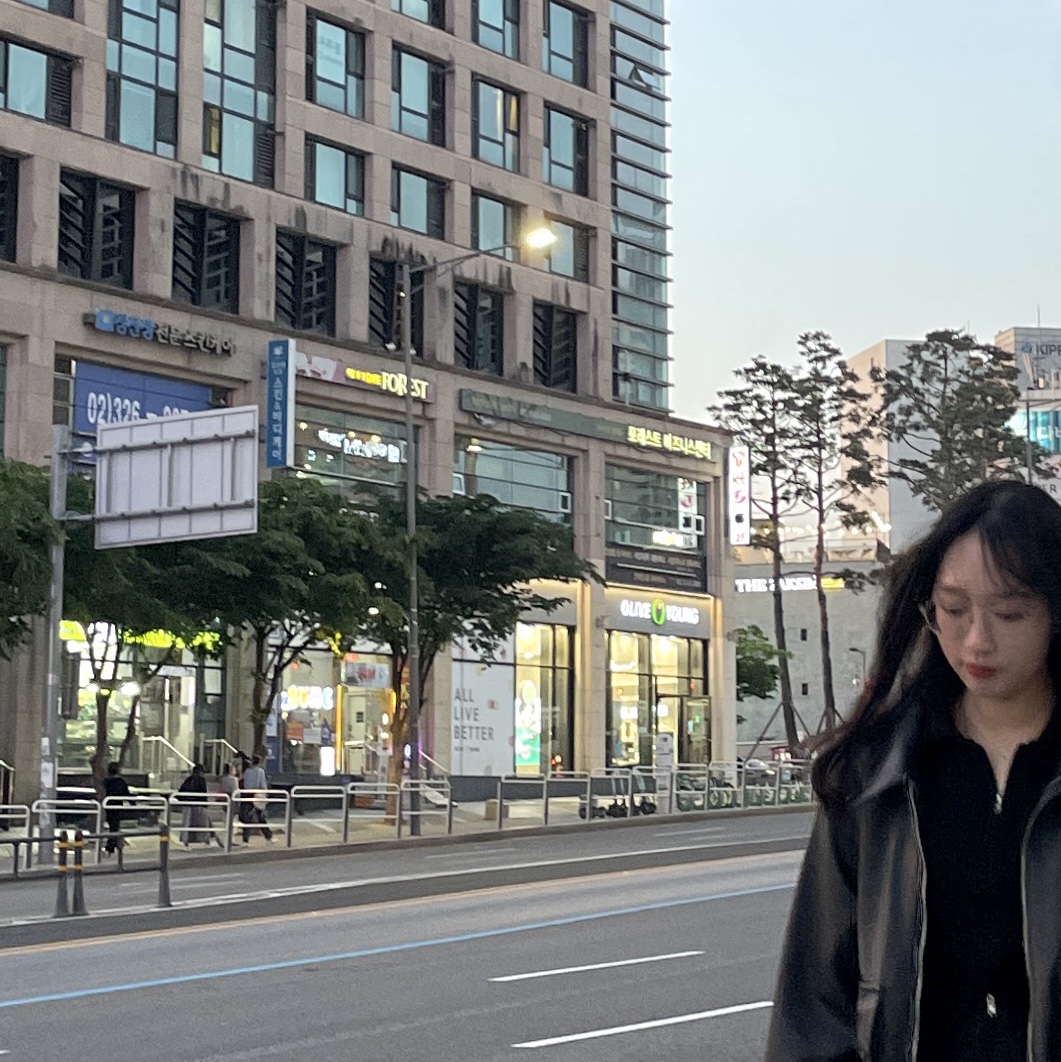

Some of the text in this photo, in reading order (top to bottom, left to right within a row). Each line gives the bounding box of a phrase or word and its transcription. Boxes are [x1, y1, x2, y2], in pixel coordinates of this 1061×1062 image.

[380, 371, 430, 399] FORST
[620, 599, 700, 624] OLIVE YOUNG
[454, 687, 475, 703] ALL
[453, 706, 480, 722] LIVE
[454, 725, 495, 741] BETTER
